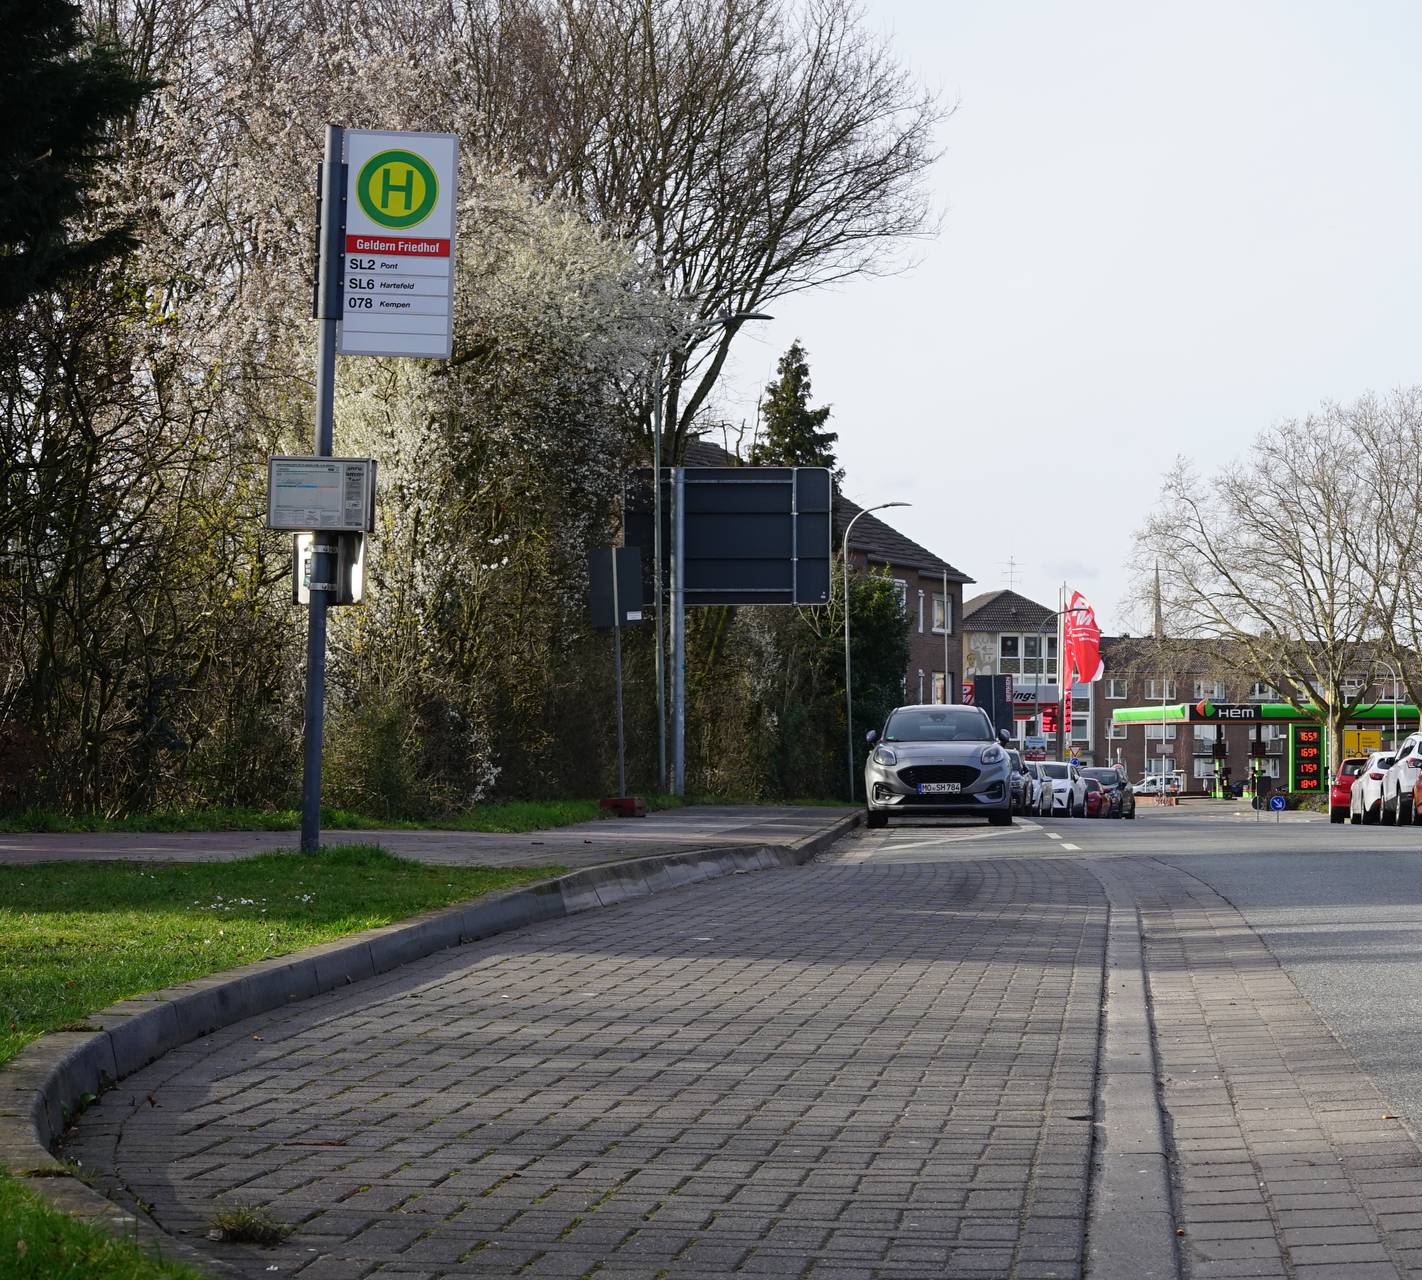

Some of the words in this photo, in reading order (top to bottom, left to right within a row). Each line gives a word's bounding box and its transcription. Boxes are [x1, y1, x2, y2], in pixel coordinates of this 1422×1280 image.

[381, 168, 414, 211] H
[356, 239, 396, 251] Geldern
[398, 241, 440, 253] Friedhof
[349, 258, 376, 270] SL2
[380, 262, 398, 270] Pont
[349, 278, 375, 290] SL6
[379, 282, 415, 290] Hartefeld
[348, 297, 373, 309] 078
[379, 301, 411, 309] Kempen
[946, 783, 960, 791] 784
